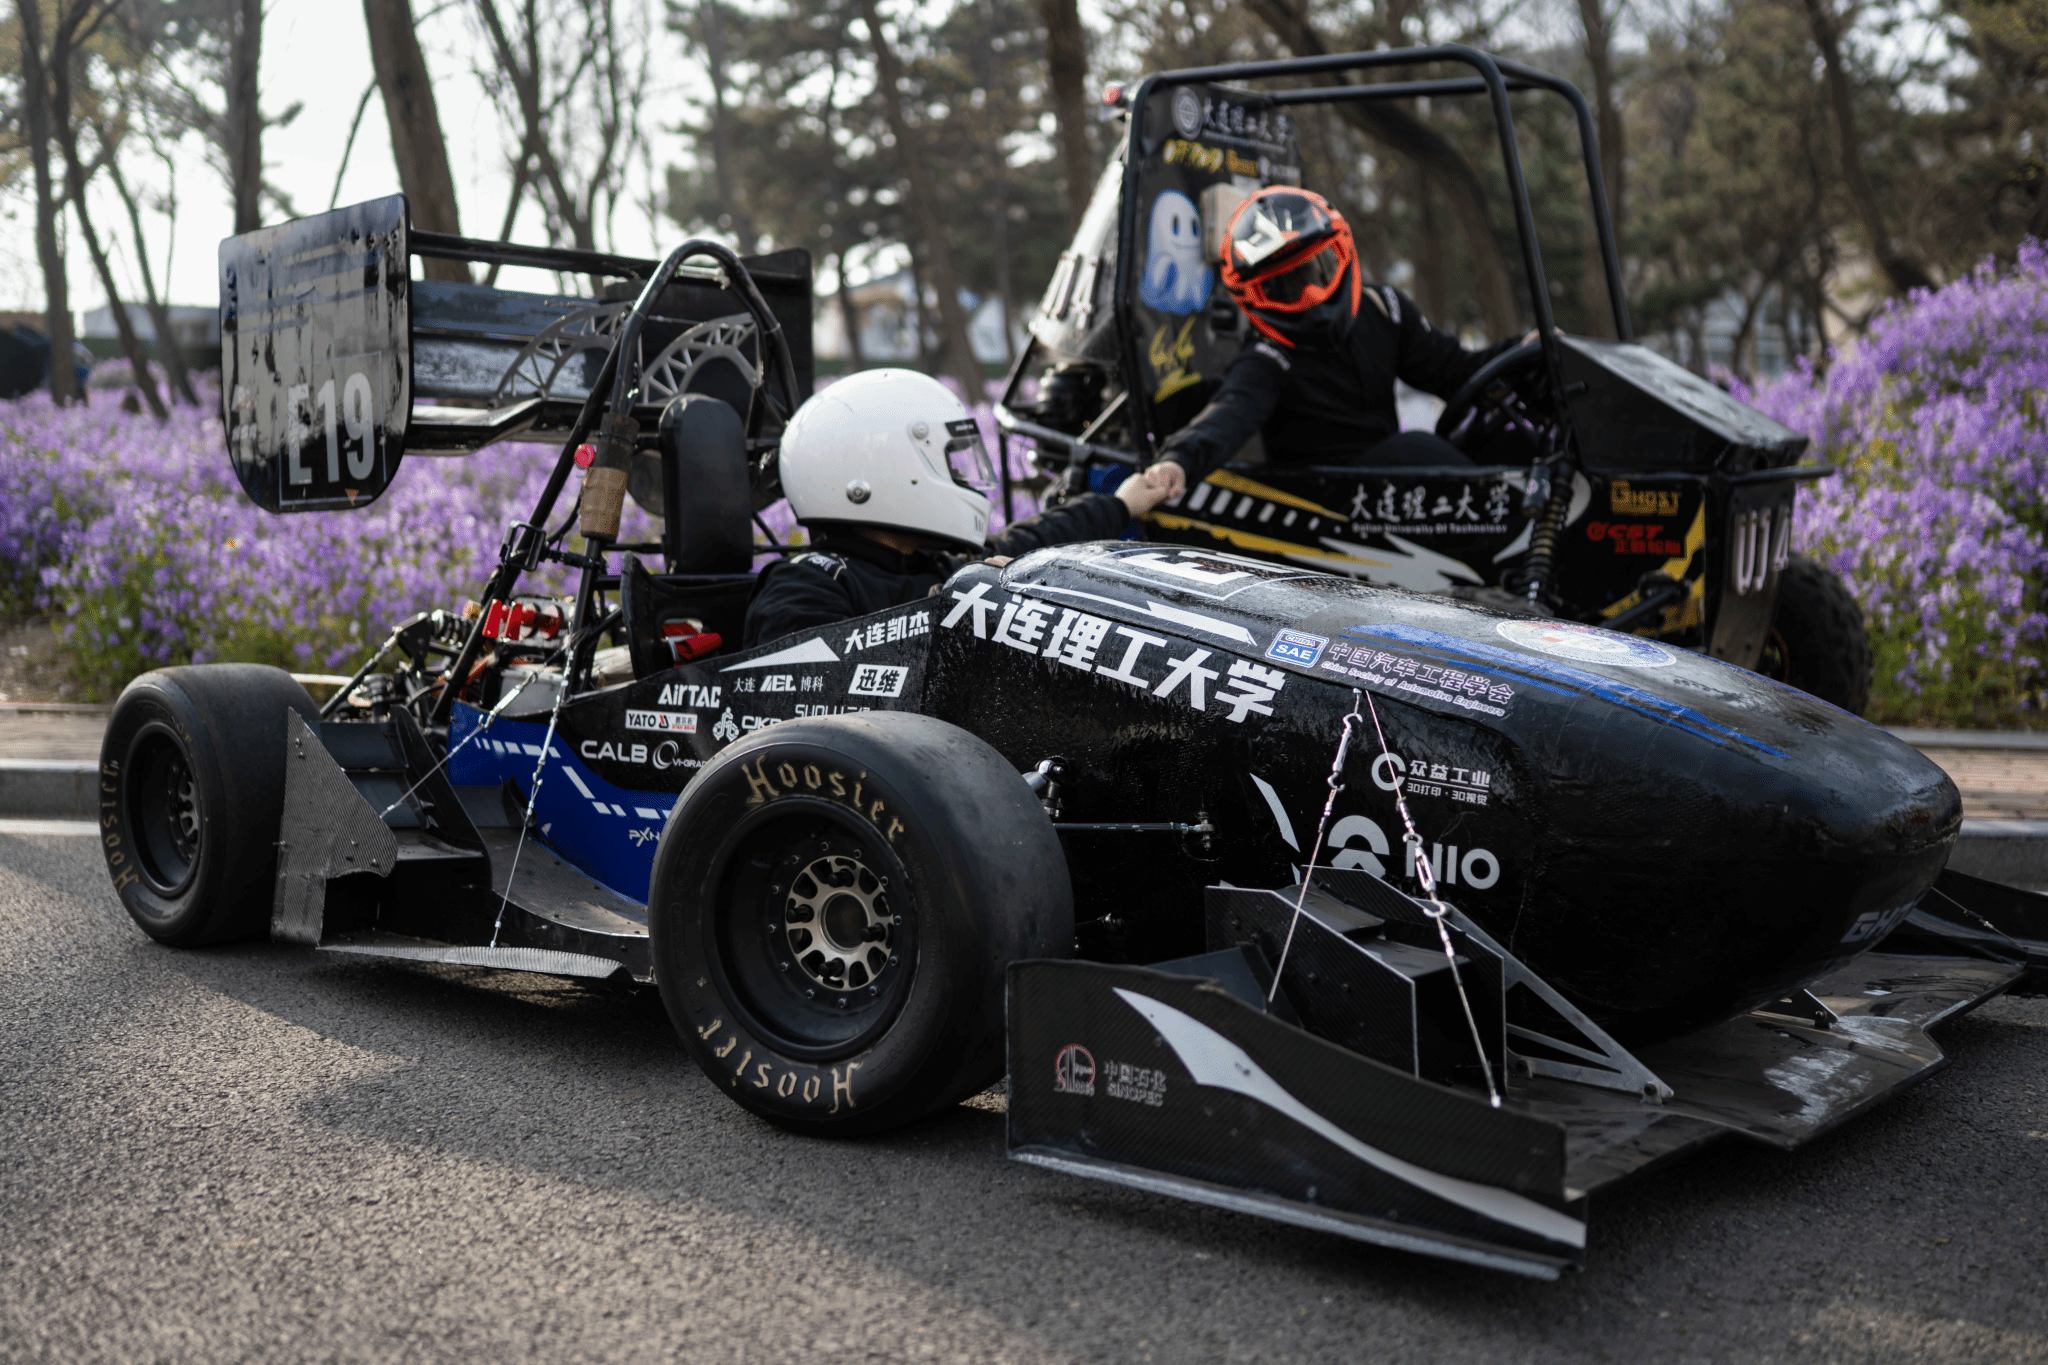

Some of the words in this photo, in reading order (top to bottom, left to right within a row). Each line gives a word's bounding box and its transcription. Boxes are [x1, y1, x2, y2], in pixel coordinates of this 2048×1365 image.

[287, 372, 375, 485] E19
[844, 611, 930, 654] 大连凯杰
[940, 582, 1286, 724] 大连理工大学
[1275, 644, 1312, 660] SAE
[733, 677, 756, 693] 大连
[800, 675, 824, 692] 博科
[856, 668, 900, 693] 迅维
[1320, 660, 1349, 674] China
[1348, 667, 1385, 684] Society
[1383, 677, 1399, 687] of
[1397, 680, 1454, 703] Automotive
[1453, 694, 1506, 717] Engineers
[1329, 643, 1514, 704] 中国汽车工程学会
[628, 713, 657, 728] YATO
[580, 741, 648, 764] CALB
[671, 757, 707, 769] VI-GRAD
[1410, 760, 1491, 788] 众益工业
[740, 752, 905, 840] Hoosier
[101, 760, 140, 894] Hoosier
[628, 826, 661, 848] PXN
[1406, 840, 1500, 889] NIO
[698, 1018, 862, 1114] Hoosier
[1106, 1081, 1164, 1107] SINOPEC
